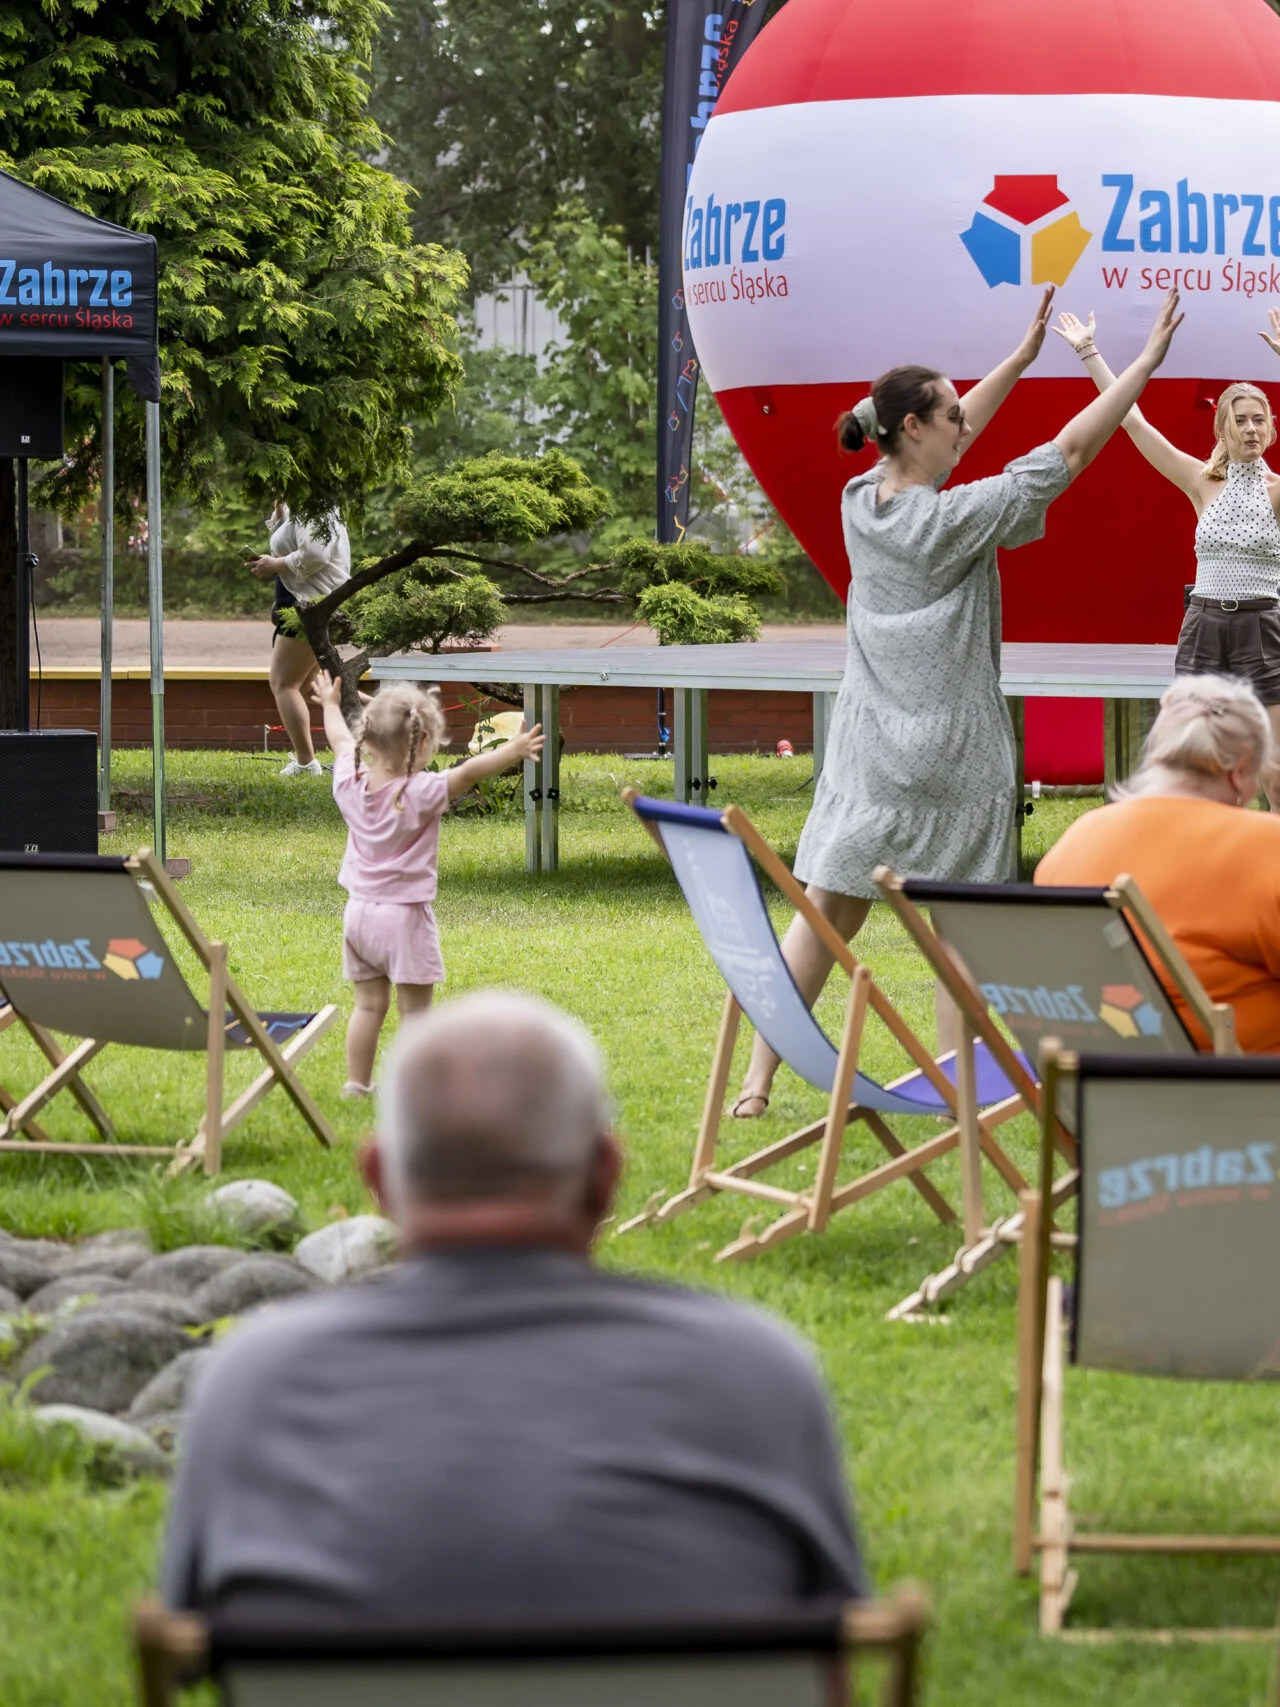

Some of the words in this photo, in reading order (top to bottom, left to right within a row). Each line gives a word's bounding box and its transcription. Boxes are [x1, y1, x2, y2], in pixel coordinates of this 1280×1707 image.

[684, 192, 786, 271] Zabrze
[0, 260, 133, 307] Zabrze
[692, 280, 726, 305] sercu
[730, 266, 788, 304] Śląska
[1102, 267, 1128, 289] w
[1140, 267, 1211, 290] sercu
[20, 312, 68, 327] sercu
[75, 307, 133, 330] Śląska
